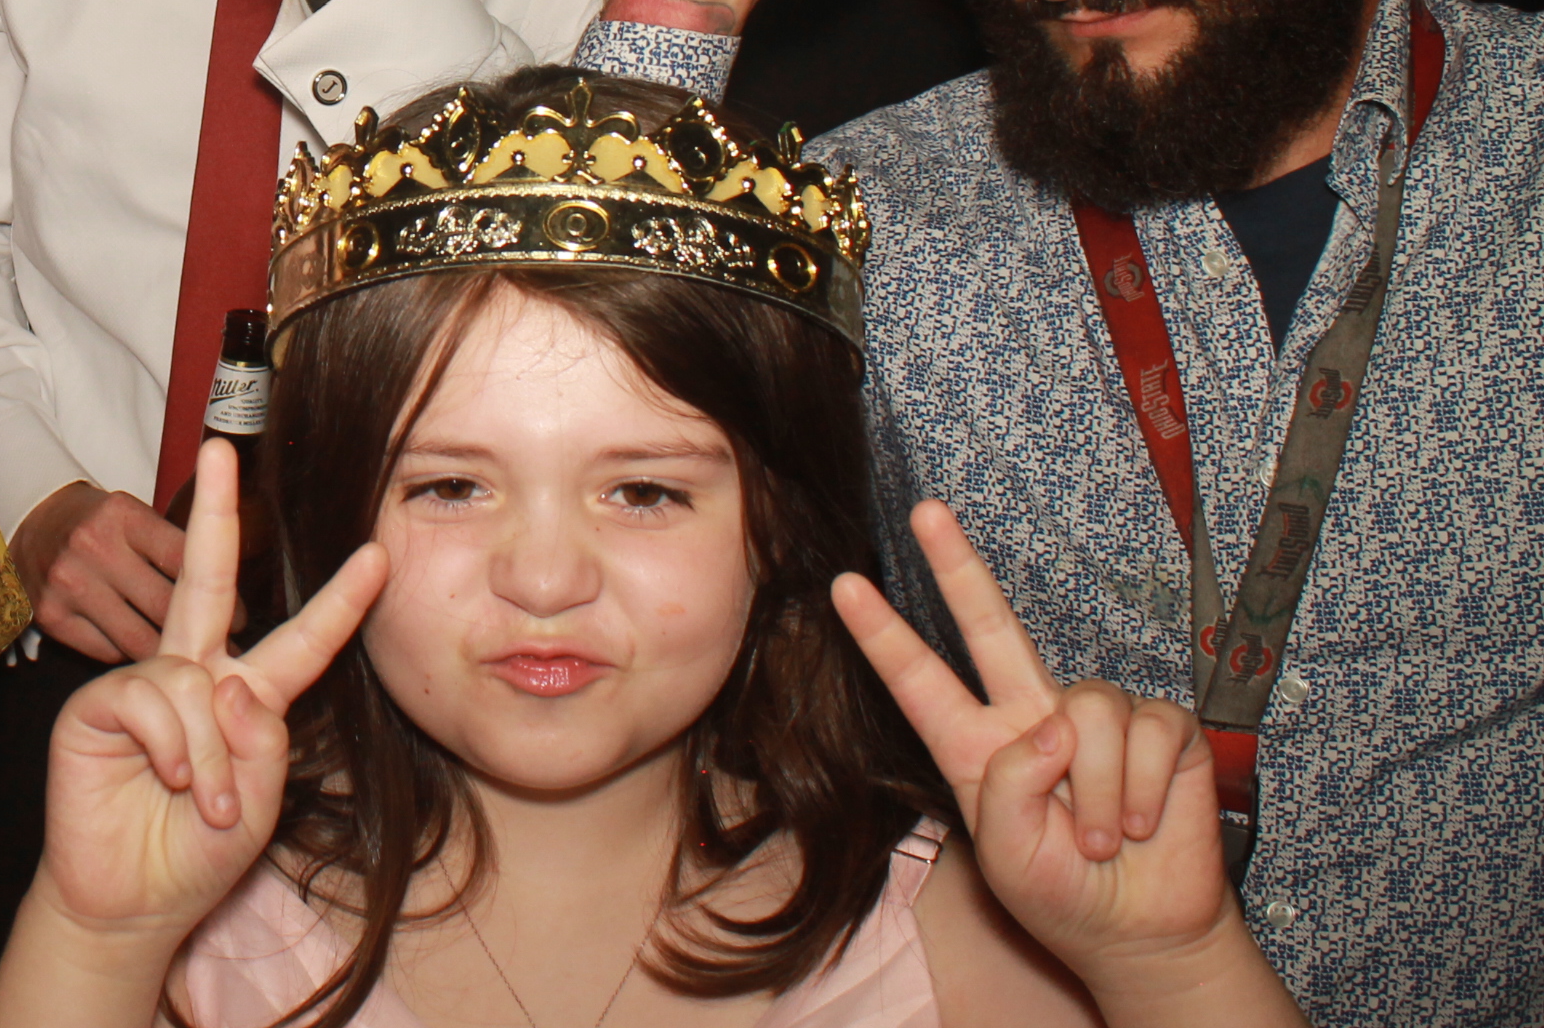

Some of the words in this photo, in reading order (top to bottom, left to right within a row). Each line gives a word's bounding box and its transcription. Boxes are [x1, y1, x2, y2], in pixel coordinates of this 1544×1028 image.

[211, 377, 258, 396] Miller
[1140, 359, 1169, 412] STATE
[1148, 407, 1186, 440] OHIO
